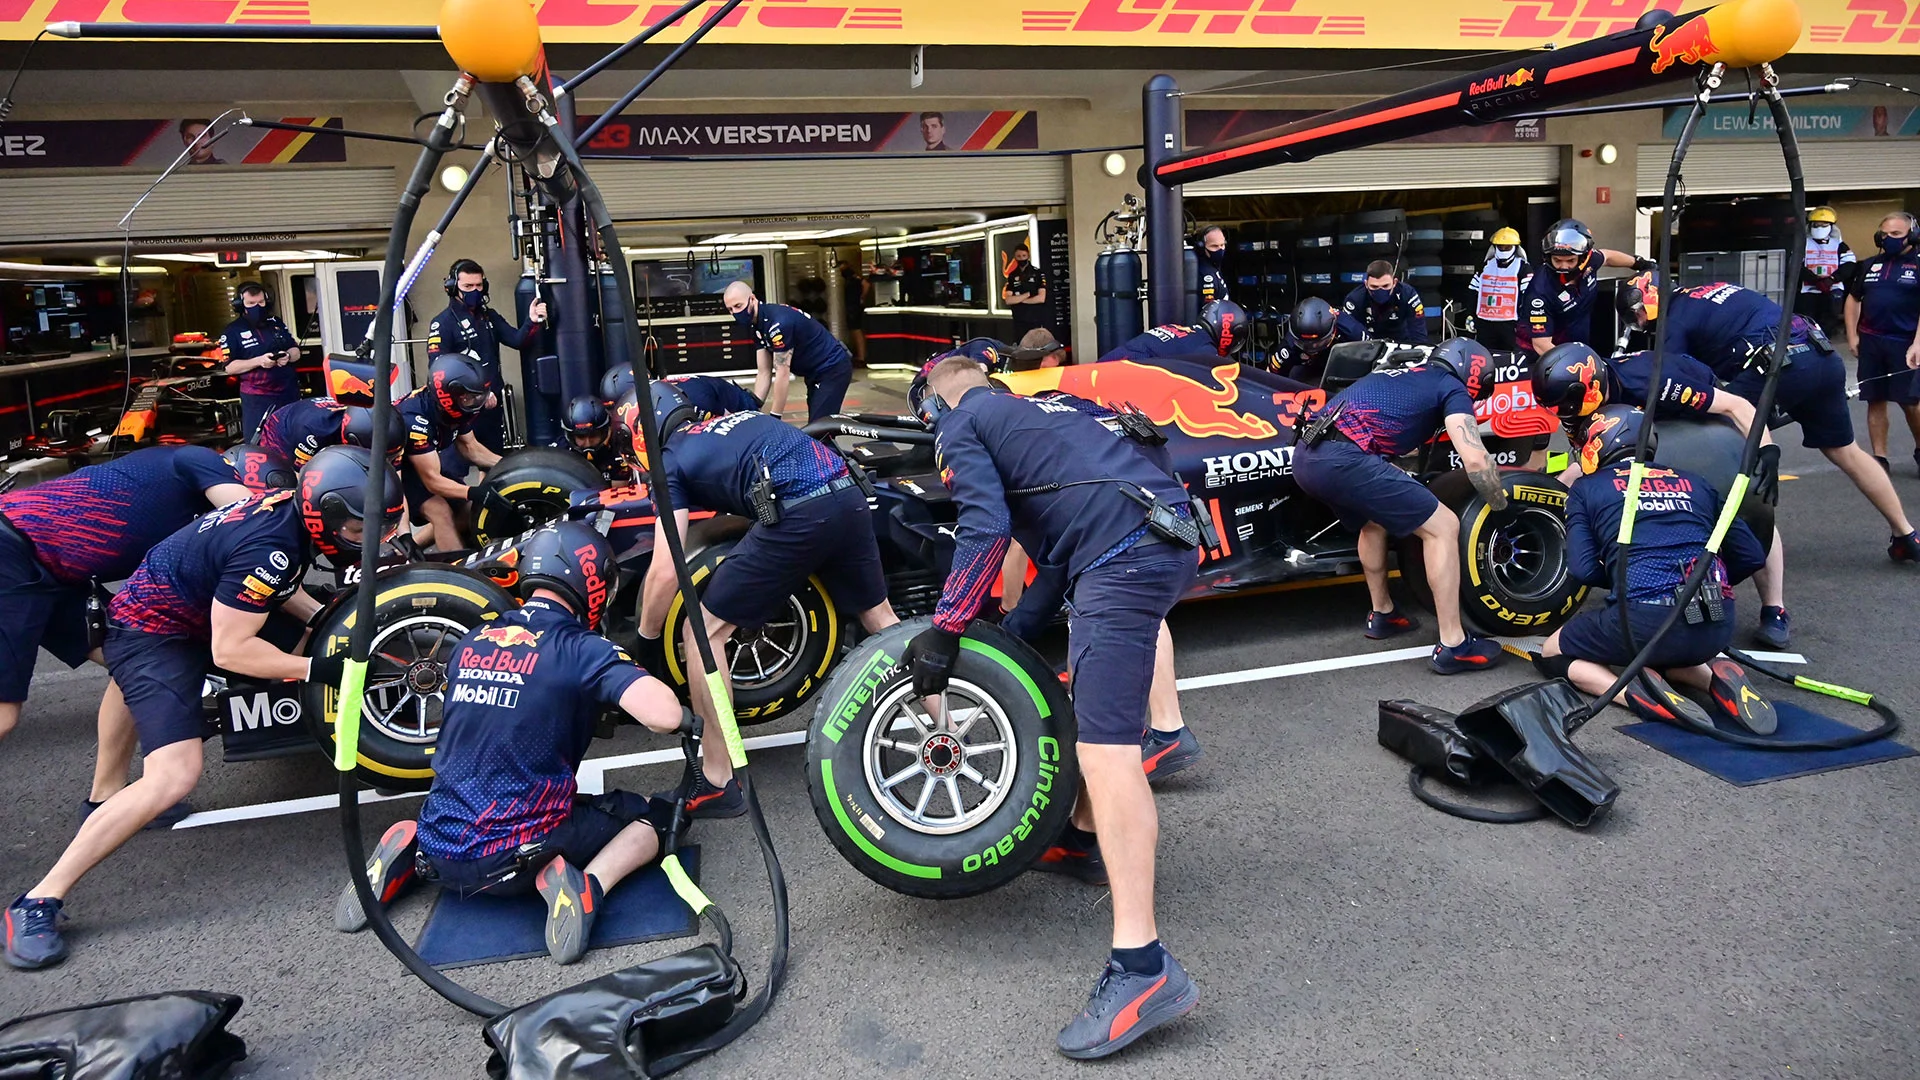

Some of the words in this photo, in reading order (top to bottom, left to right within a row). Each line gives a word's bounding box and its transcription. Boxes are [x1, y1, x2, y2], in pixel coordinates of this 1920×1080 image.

[1072, 0, 1323, 35] DHL
[913, 54, 919, 75] 8
[1471, 90, 1540, 111] RACING
[1763, 115, 1842, 130] HMILTON
[639, 126, 701, 146] MAX
[705, 123, 871, 145] VERSTAPPEN
[215, 233, 297, 243] REDBULLRACING.COM
[187, 378, 211, 392] ORACLE
[847, 426, 870, 437] Tezos
[1513, 484, 1568, 507] PIRELL
[1613, 478, 1653, 492] Rd
[1653, 478, 1693, 492] Bull
[1234, 502, 1264, 516] SIEMENS
[254, 566, 279, 584] Claro
[1479, 594, 1552, 626] ZERO
[458, 646, 499, 670] Red
[494, 649, 540, 675] Bull
[457, 668, 525, 685] HONDA
[452, 683, 499, 706] Mobil
[962, 736, 1060, 874] Cinturato
